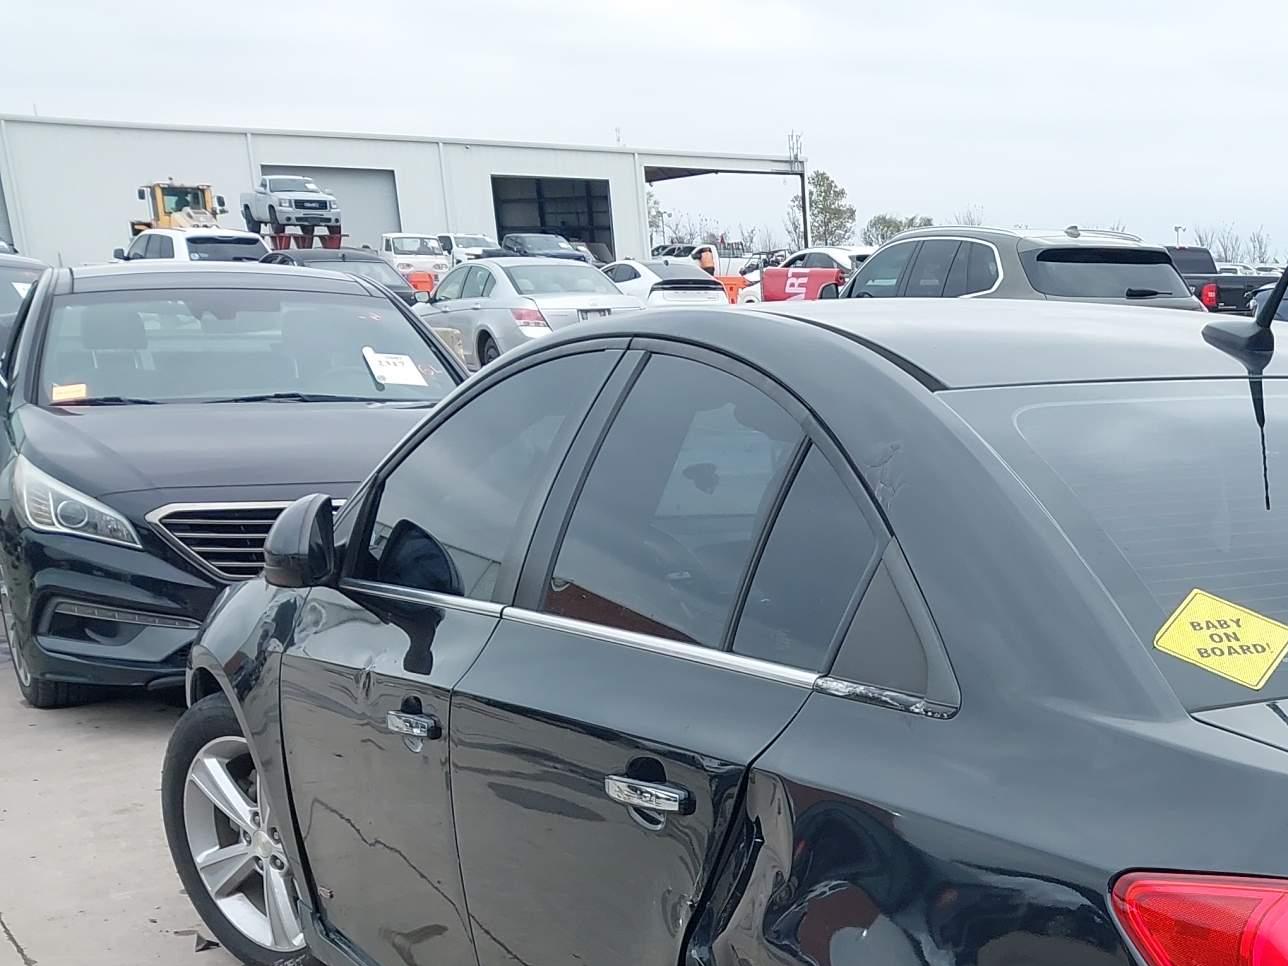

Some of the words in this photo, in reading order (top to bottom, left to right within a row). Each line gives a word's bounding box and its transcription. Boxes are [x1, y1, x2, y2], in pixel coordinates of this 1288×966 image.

[1190, 618, 1242, 632] BABY
[1209, 631, 1241, 643] ON
[1197, 643, 1275, 658] BOARD!
